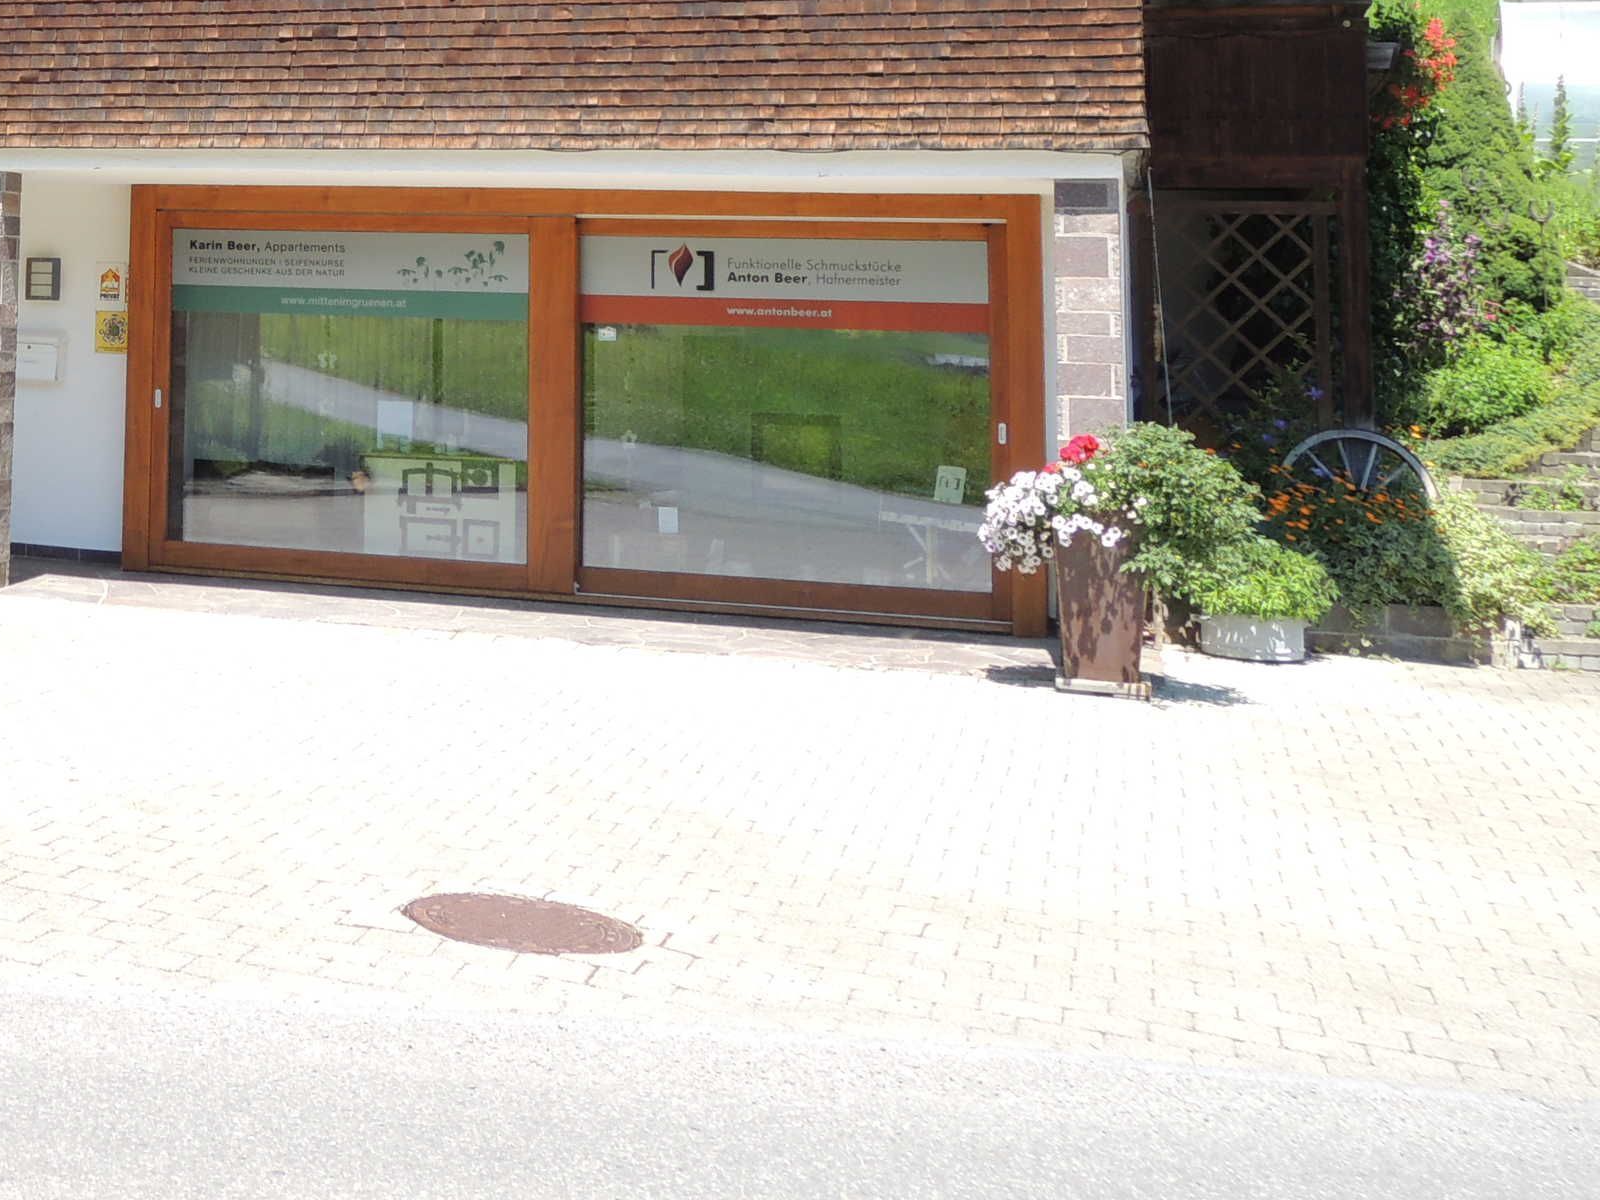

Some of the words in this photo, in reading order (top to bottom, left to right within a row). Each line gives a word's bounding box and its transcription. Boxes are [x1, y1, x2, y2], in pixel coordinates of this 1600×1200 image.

[190, 240, 223, 251] Karin
[227, 241, 260, 253] Beer,
[265, 242, 346, 254] Appartements
[728, 258, 802, 271] Funktionelle
[806, 259, 902, 273] Schmuckstücke
[727, 272, 769, 284] Anton
[816, 273, 902, 287] Hafnermeister
[281, 295, 407, 308] www.mittenimgruenen.at
[727, 306, 833, 318] www.antonbeer.at
